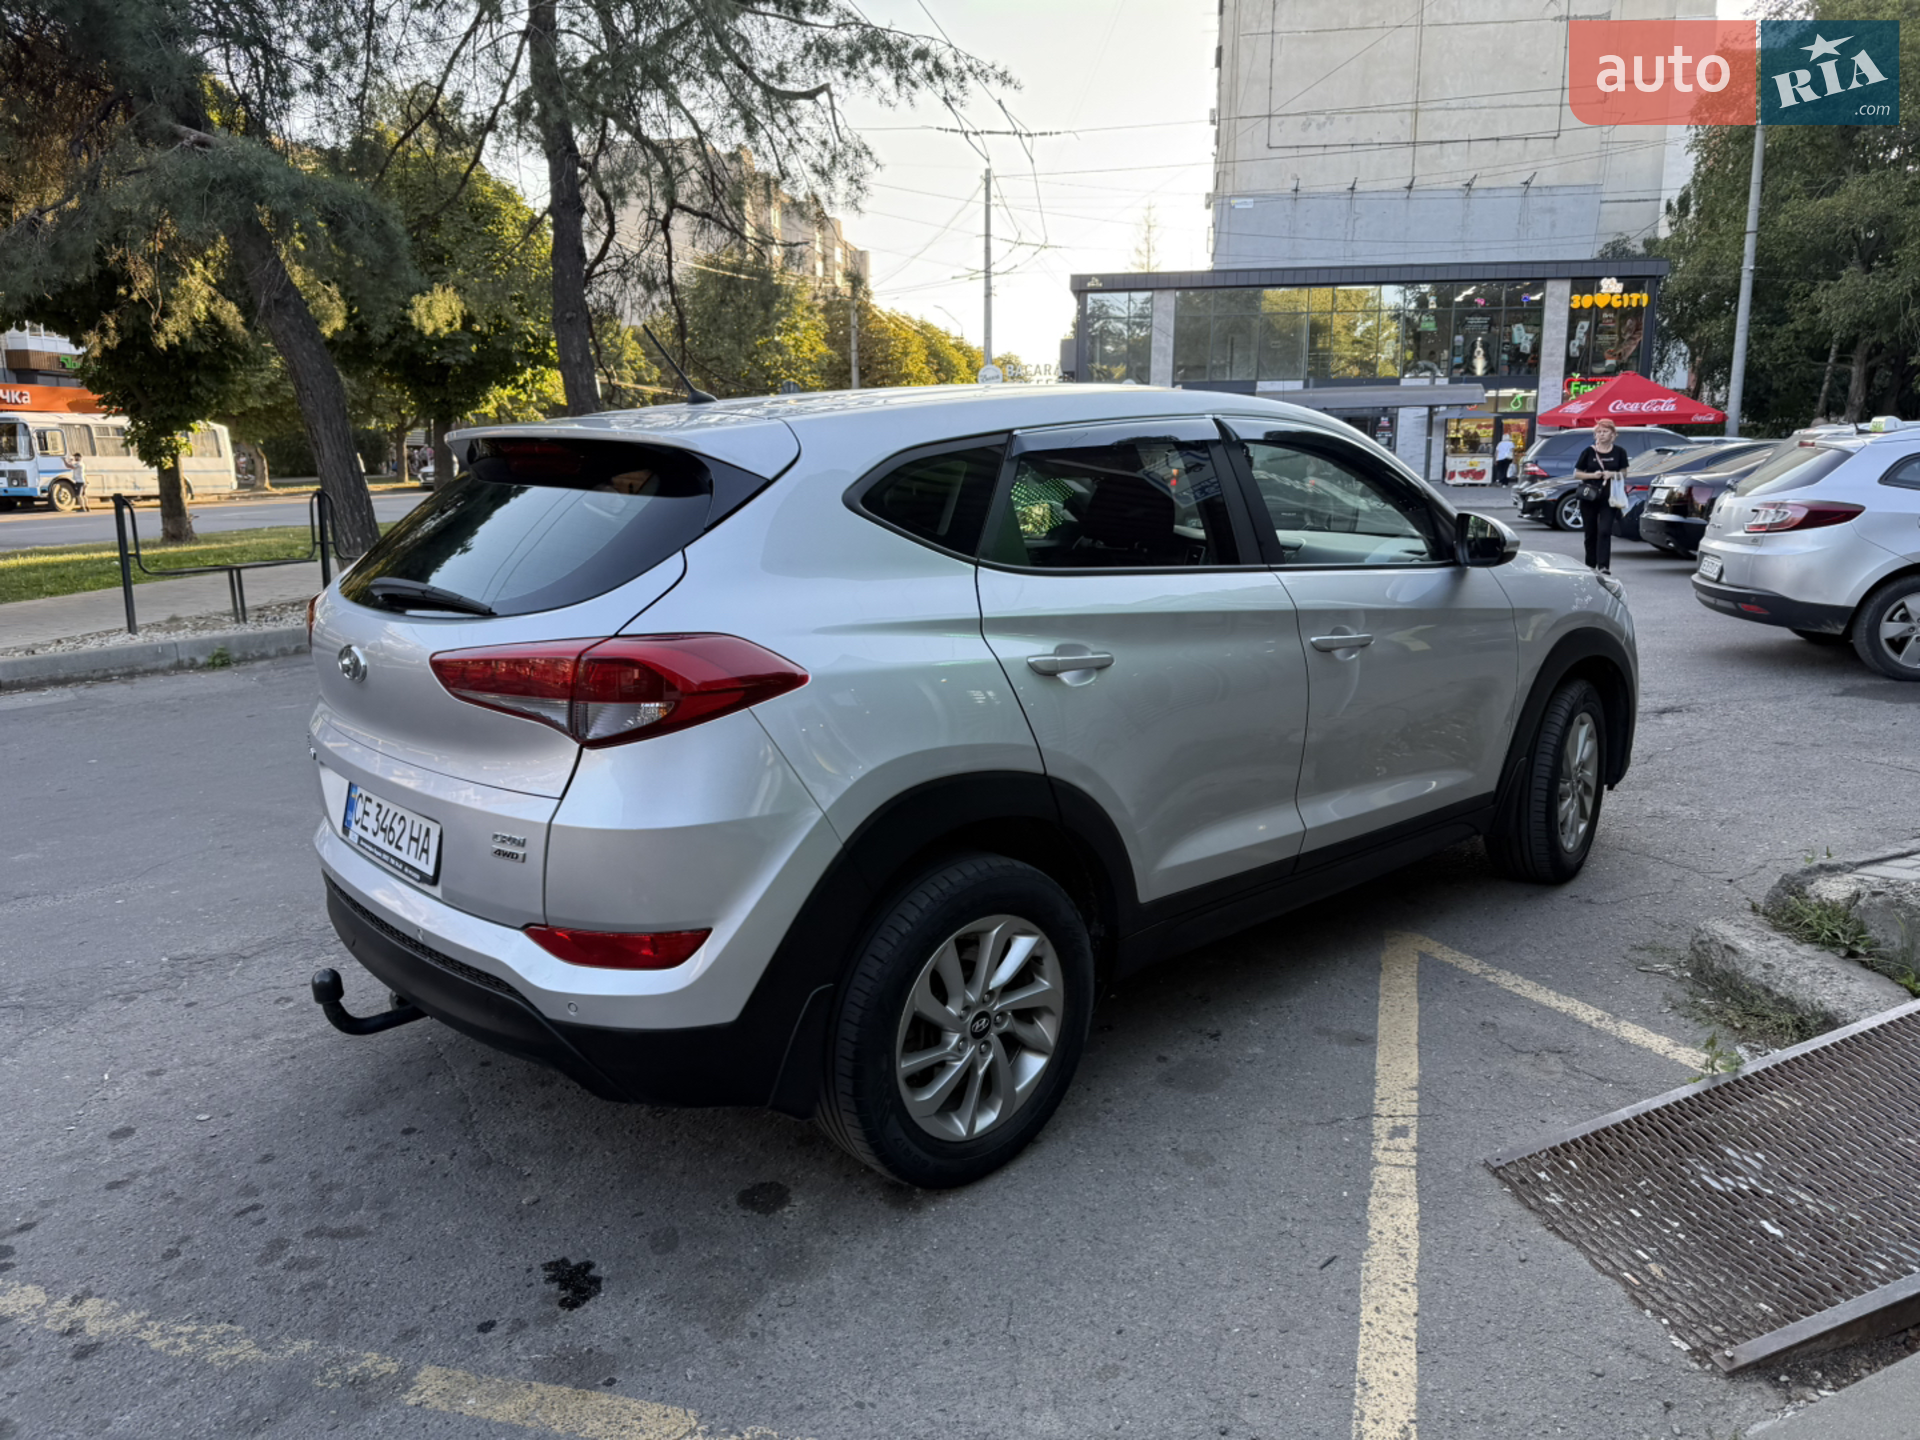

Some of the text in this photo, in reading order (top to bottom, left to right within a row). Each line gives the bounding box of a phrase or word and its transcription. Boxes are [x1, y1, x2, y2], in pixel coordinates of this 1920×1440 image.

[1006, 363, 1064, 377] BACARA
[1570, 381, 1605, 395] Fru
[1608, 396, 1677, 414] Coca-Cola
[354, 792, 373, 833] CE
[371, 802, 407, 852] 3462
[406, 819, 431, 866] HA
[493, 848, 520, 861] 4WD
